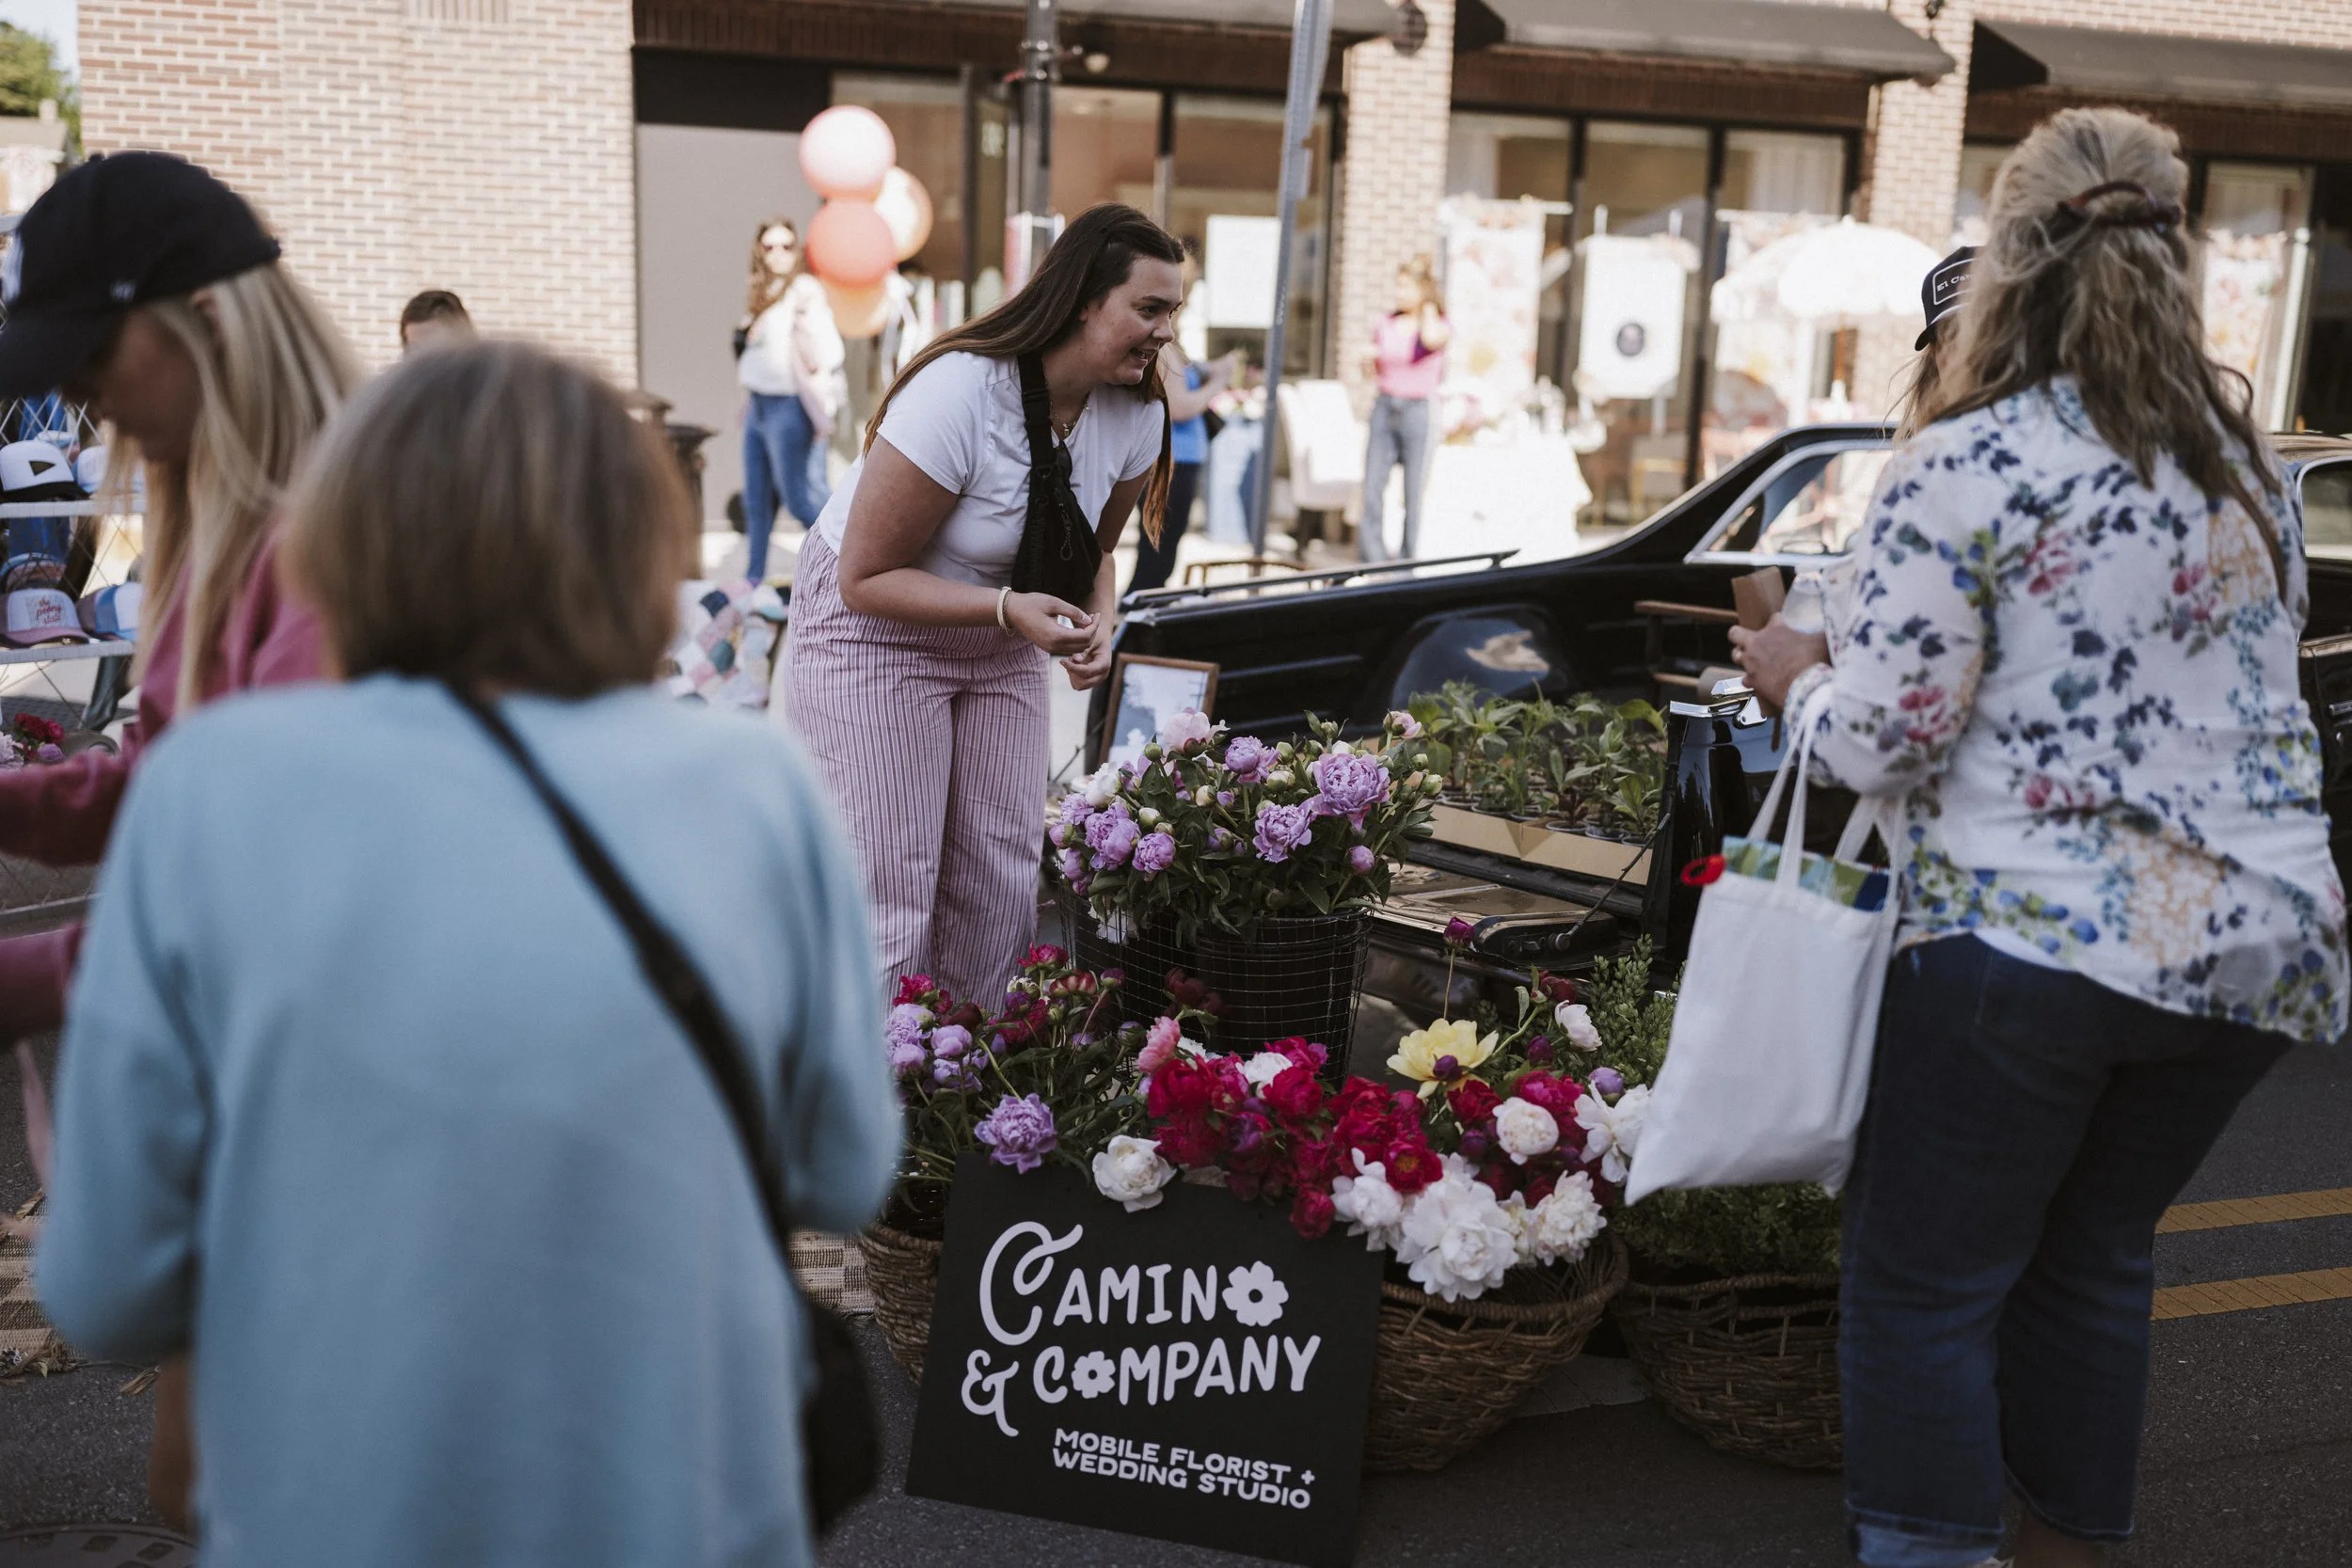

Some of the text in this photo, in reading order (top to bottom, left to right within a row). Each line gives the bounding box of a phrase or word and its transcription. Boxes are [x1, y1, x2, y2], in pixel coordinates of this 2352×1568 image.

[1936, 280, 1948, 293] El
[961, 1334, 1322, 1437] & COMPANY
[1052, 1448, 1311, 1509] WEDDING STUDIO
[1055, 1428, 1161, 1464] MOBILE
[1169, 1447, 1292, 1484] FLORIST
